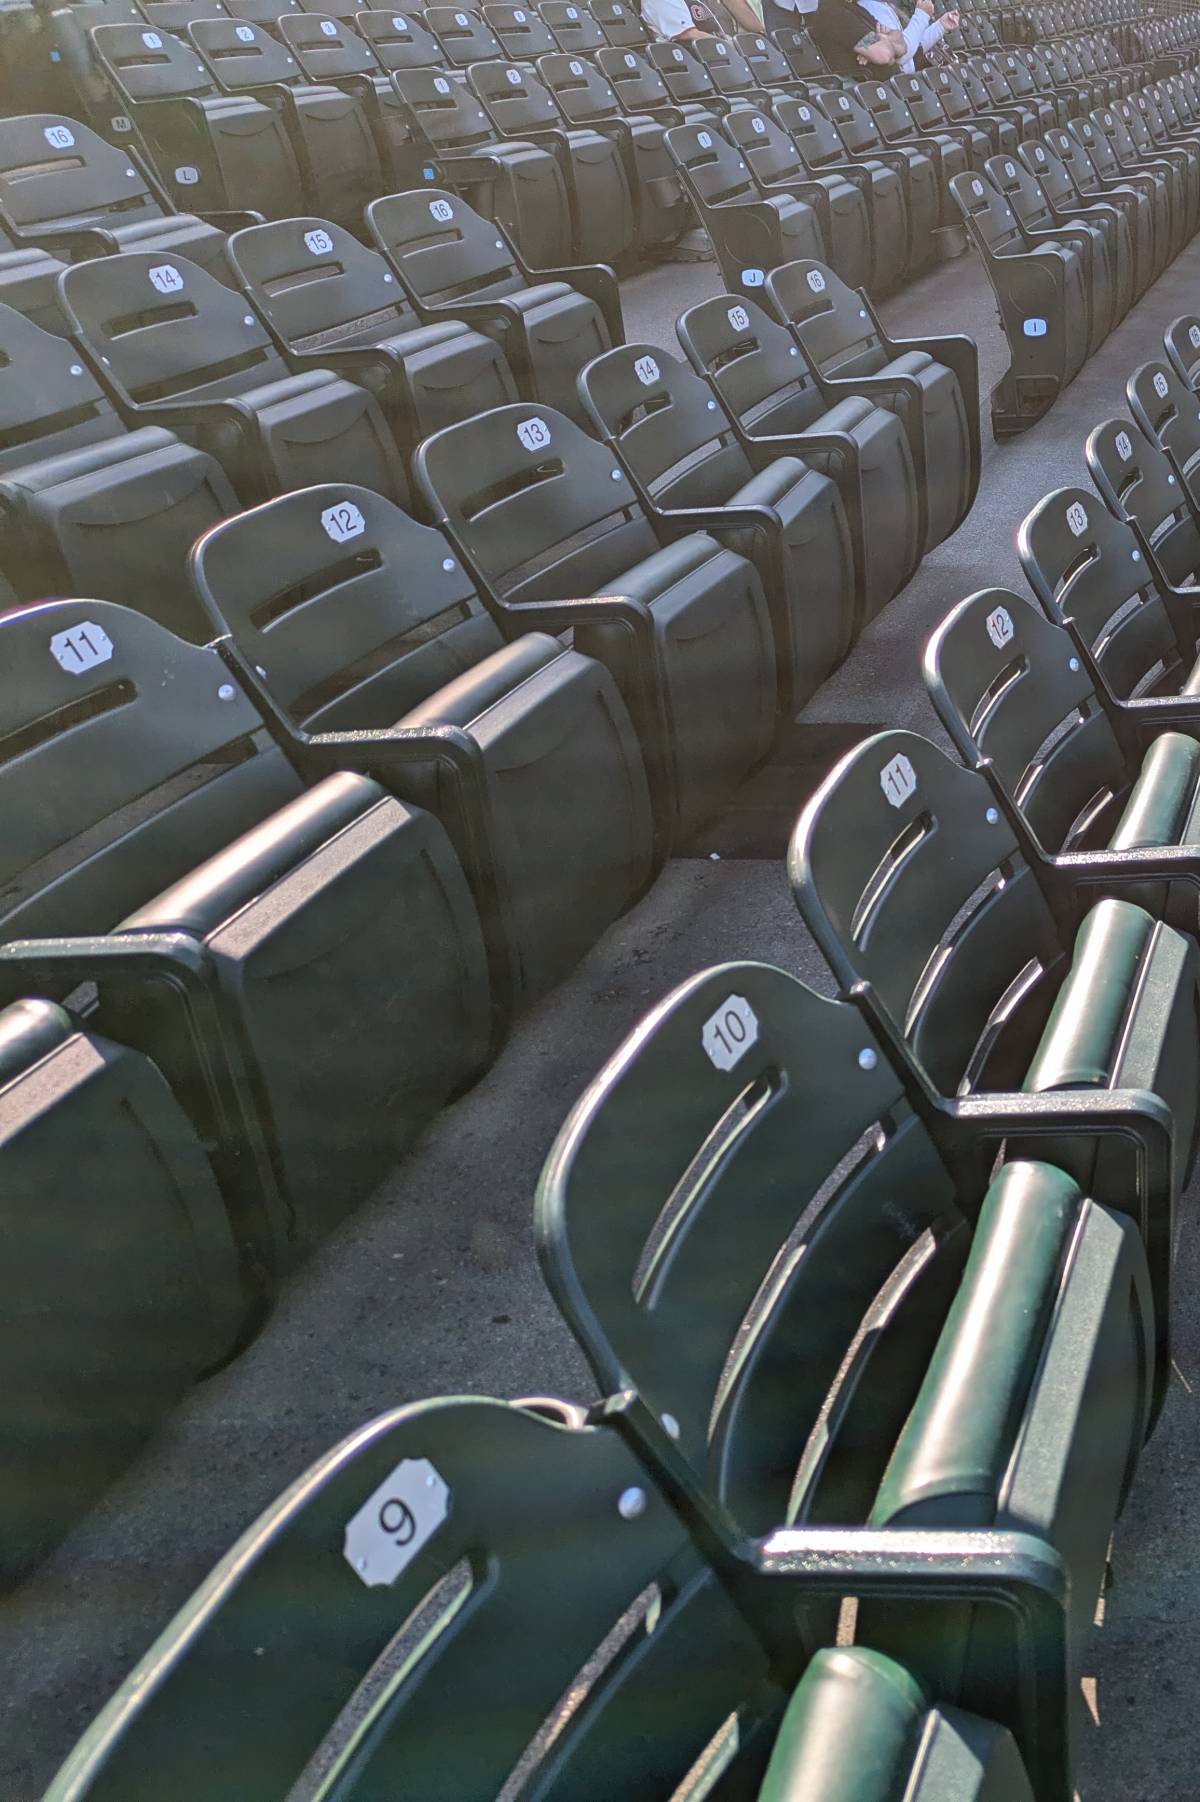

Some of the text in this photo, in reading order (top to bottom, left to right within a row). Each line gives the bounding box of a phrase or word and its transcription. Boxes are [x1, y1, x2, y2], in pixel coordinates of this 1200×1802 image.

[240, 28, 250, 39] 2
[510, 71, 518, 82] 2
[116, 119, 125, 129] M
[755, 119, 763, 130] 2
[50, 128, 68, 144] 16
[183, 170, 192, 181] L
[434, 203, 448, 218] 16
[309, 233, 328, 251] 15
[155, 269, 177, 288] 14
[749, 273, 757, 283] J
[810, 273, 822, 288] 16
[731, 310, 745, 327] 15
[1190, 329, 1200, 344] 16
[638, 361, 654, 380] 14
[1156, 375, 1166, 392] 15
[523, 423, 544, 445] 13
[1117, 437, 1130, 457] 14
[330, 509, 358, 534] 12
[1070, 508, 1084, 531] 13
[991, 613, 1010, 641] 12
[64, 630, 99, 663] 11
[887, 763, 910, 796] 11
[713, 1009, 746, 1055] 10
[378, 1497, 417, 1547] 9
